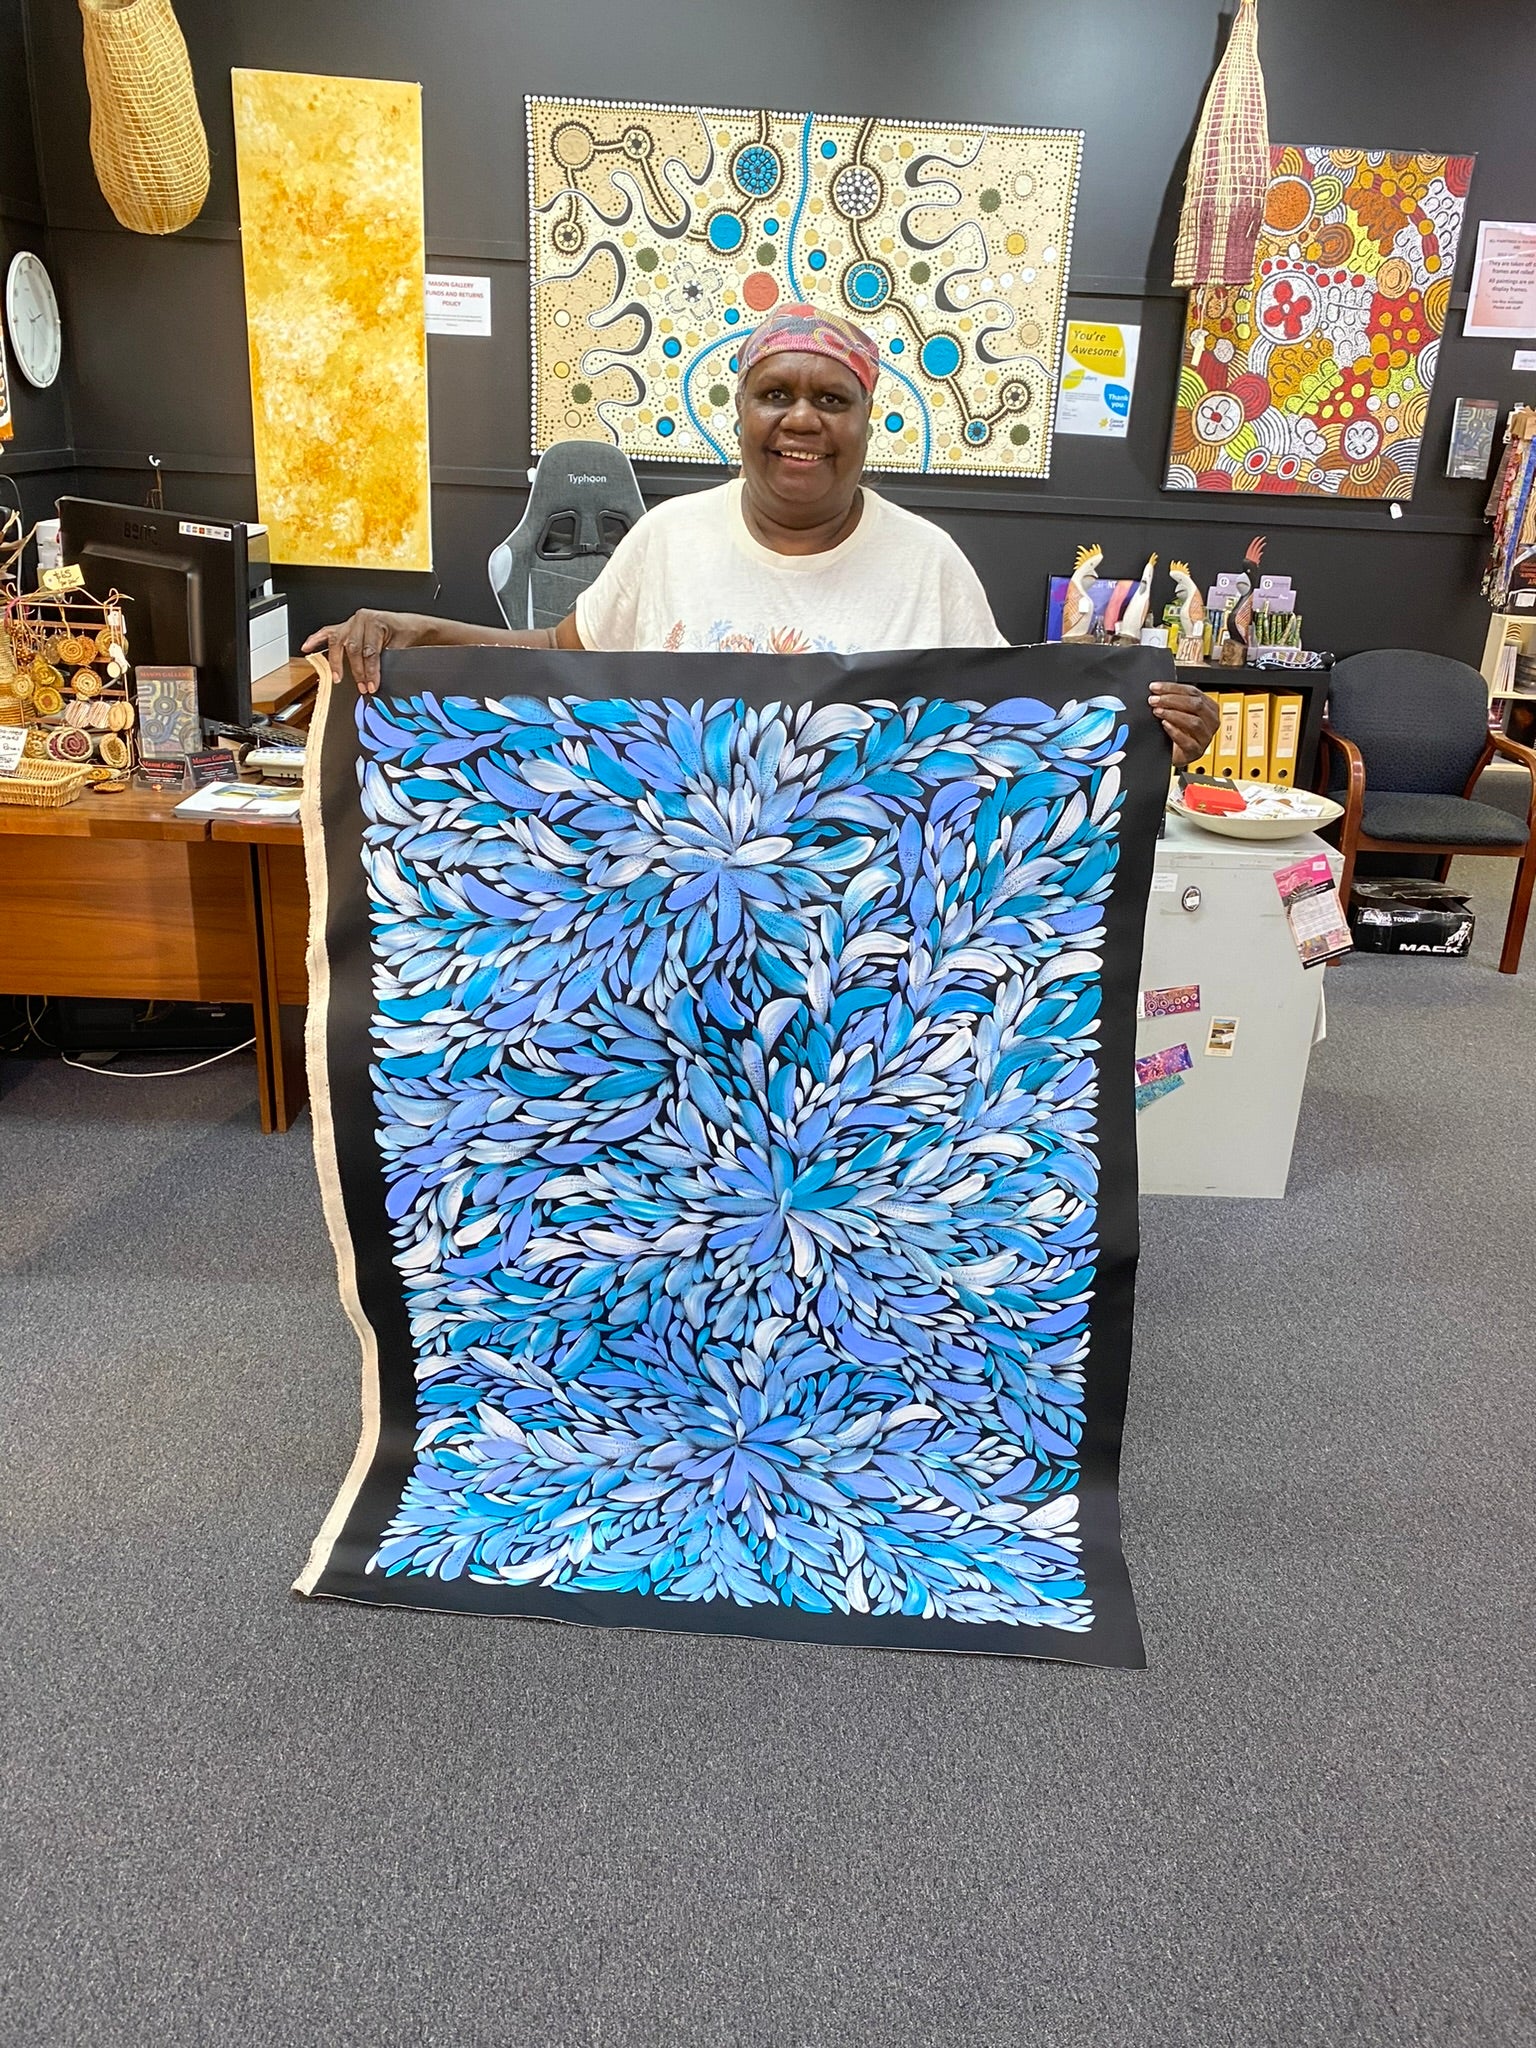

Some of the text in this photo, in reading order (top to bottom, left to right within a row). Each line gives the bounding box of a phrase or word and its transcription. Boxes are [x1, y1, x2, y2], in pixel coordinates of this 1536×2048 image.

[428, 280, 450, 288] MASON
[1496, 278, 1518, 286] paintings
[458, 291, 484, 299] RETURNS
[1074, 330, 1106, 342] You're
[1108, 393, 1129, 401] Thank
[568, 473, 607, 485] Typhoon
[192, 754, 233, 765] Mason Gallery
[142, 760, 184, 770] Mason Gallery
[1398, 943, 1461, 954] MACK
